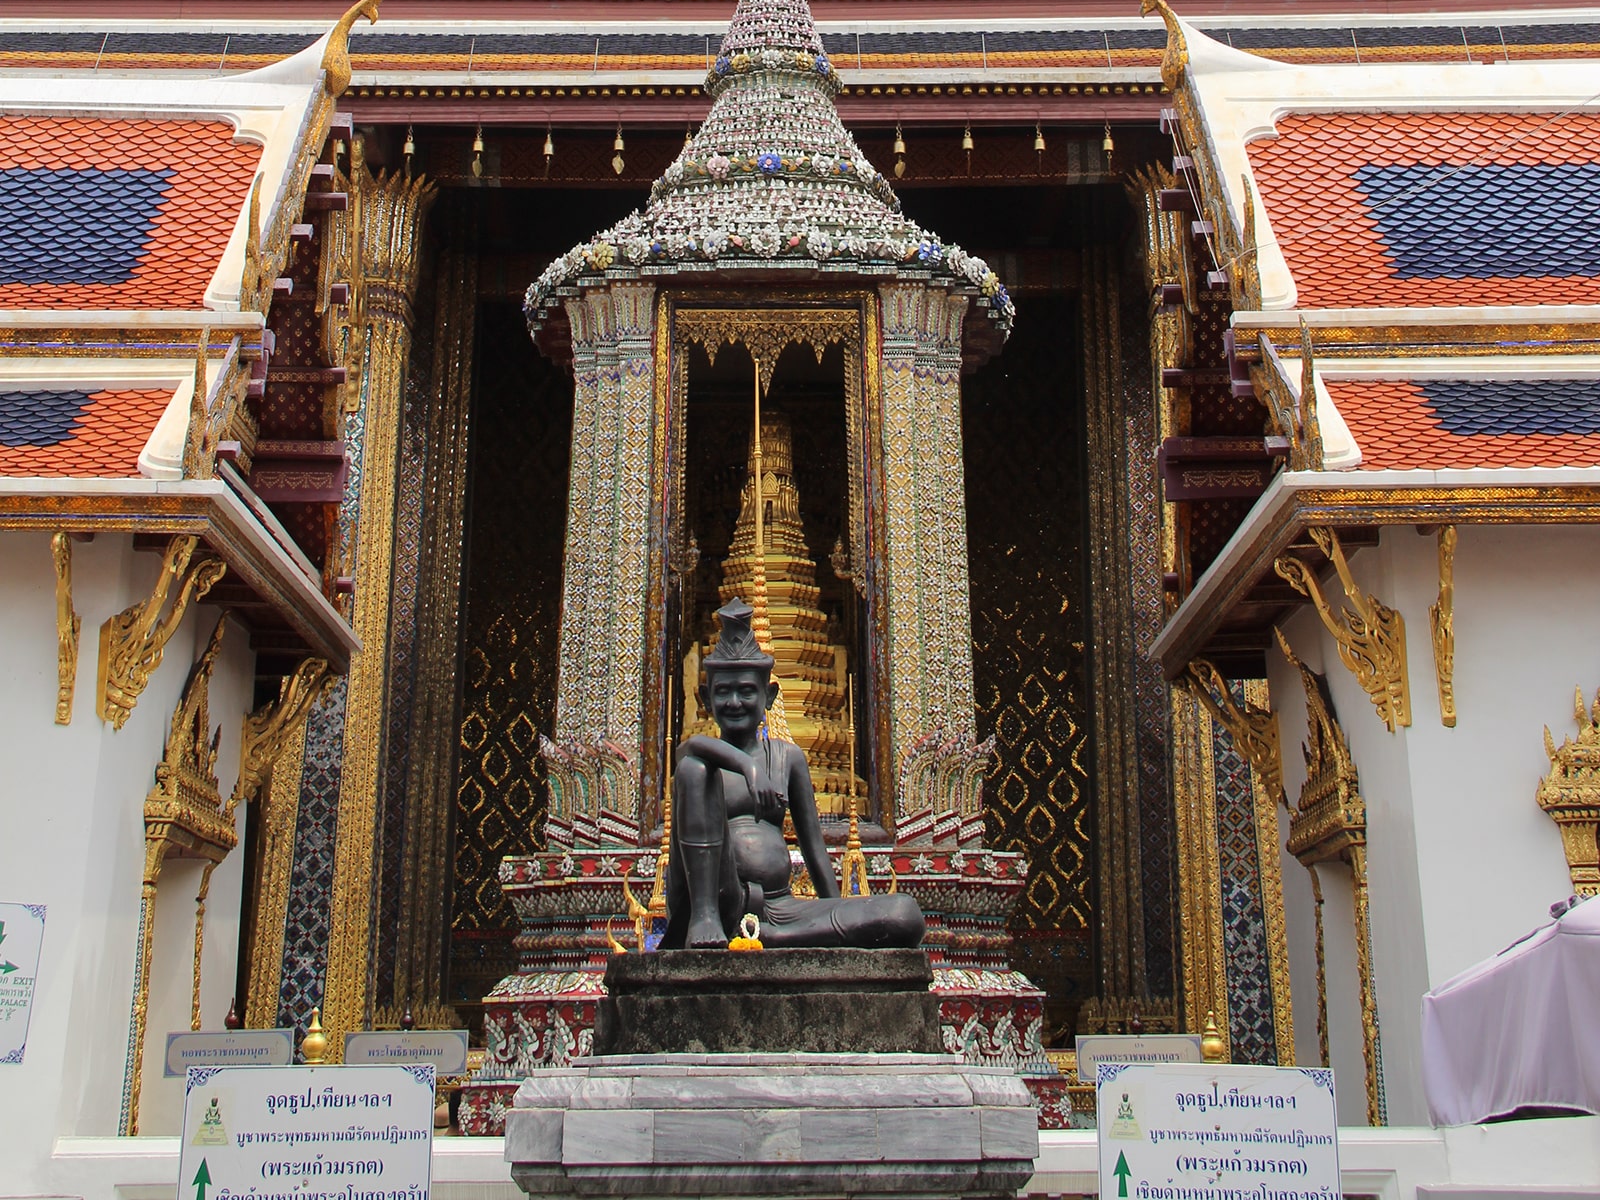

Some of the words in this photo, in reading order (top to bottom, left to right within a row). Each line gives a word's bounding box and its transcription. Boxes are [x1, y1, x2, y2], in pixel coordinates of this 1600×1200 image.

[13, 976, 34, 985] EXIT
[0, 998, 27, 1006] PALACE
[266, 1087, 392, 1114] จุดธูป,เทียนฯลฯ
[1175, 1086, 1296, 1113] จุดธูป,เทียนฯลฯ
[236, 1126, 428, 1147] บูชาพระพุทธมหามณีรัตนปฏิมากร
[261, 1154, 384, 1177] (พระแก้วมรกต)
[1176, 1149, 1308, 1176] (พระแก้วมรกต)
